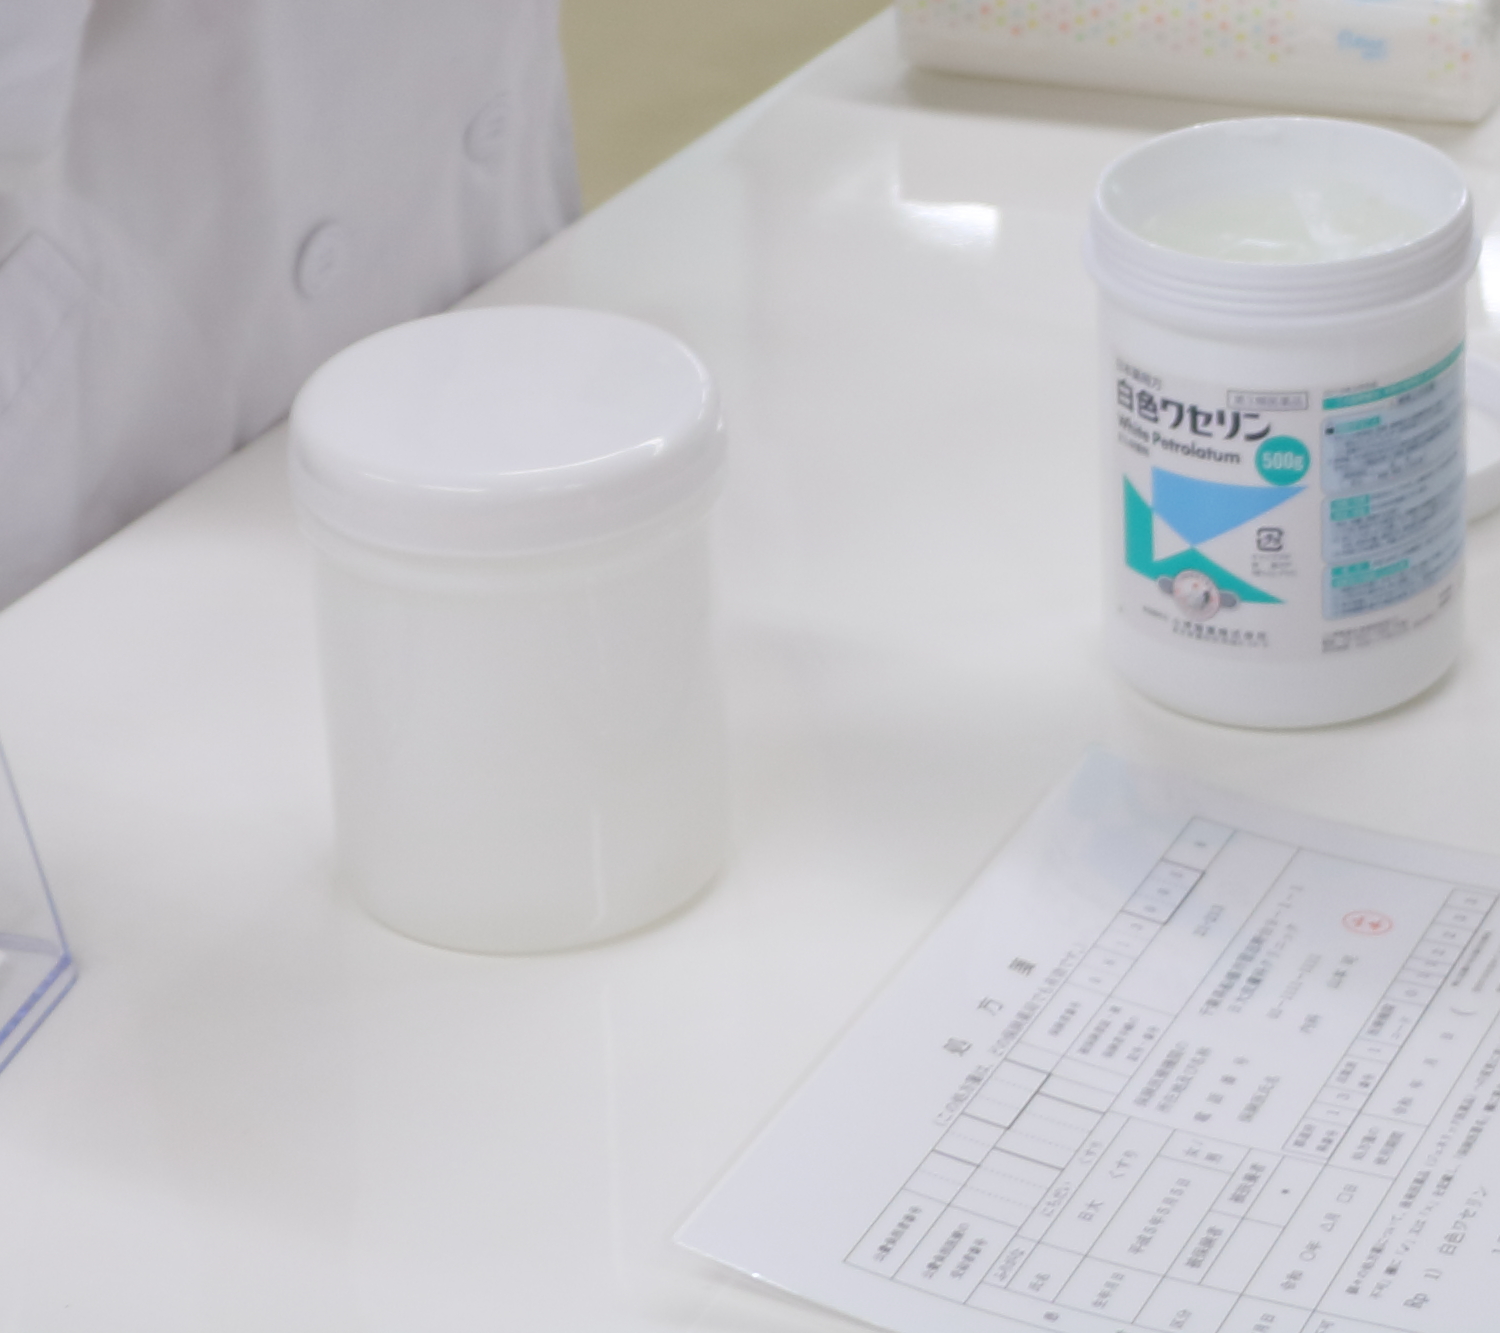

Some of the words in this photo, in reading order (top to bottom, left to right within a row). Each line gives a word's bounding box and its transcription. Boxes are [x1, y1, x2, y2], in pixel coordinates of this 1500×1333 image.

[1117, 379, 1270, 440] 白色ワセリン
[1152, 431, 1240, 464] Petrolatum
[1262, 452, 1304, 469] 500g
[1076, 1197, 1104, 1222] 日大
[1107, 1148, 1140, 1179] くすり
[1436, 1183, 1491, 1256] 白色ワセリン
